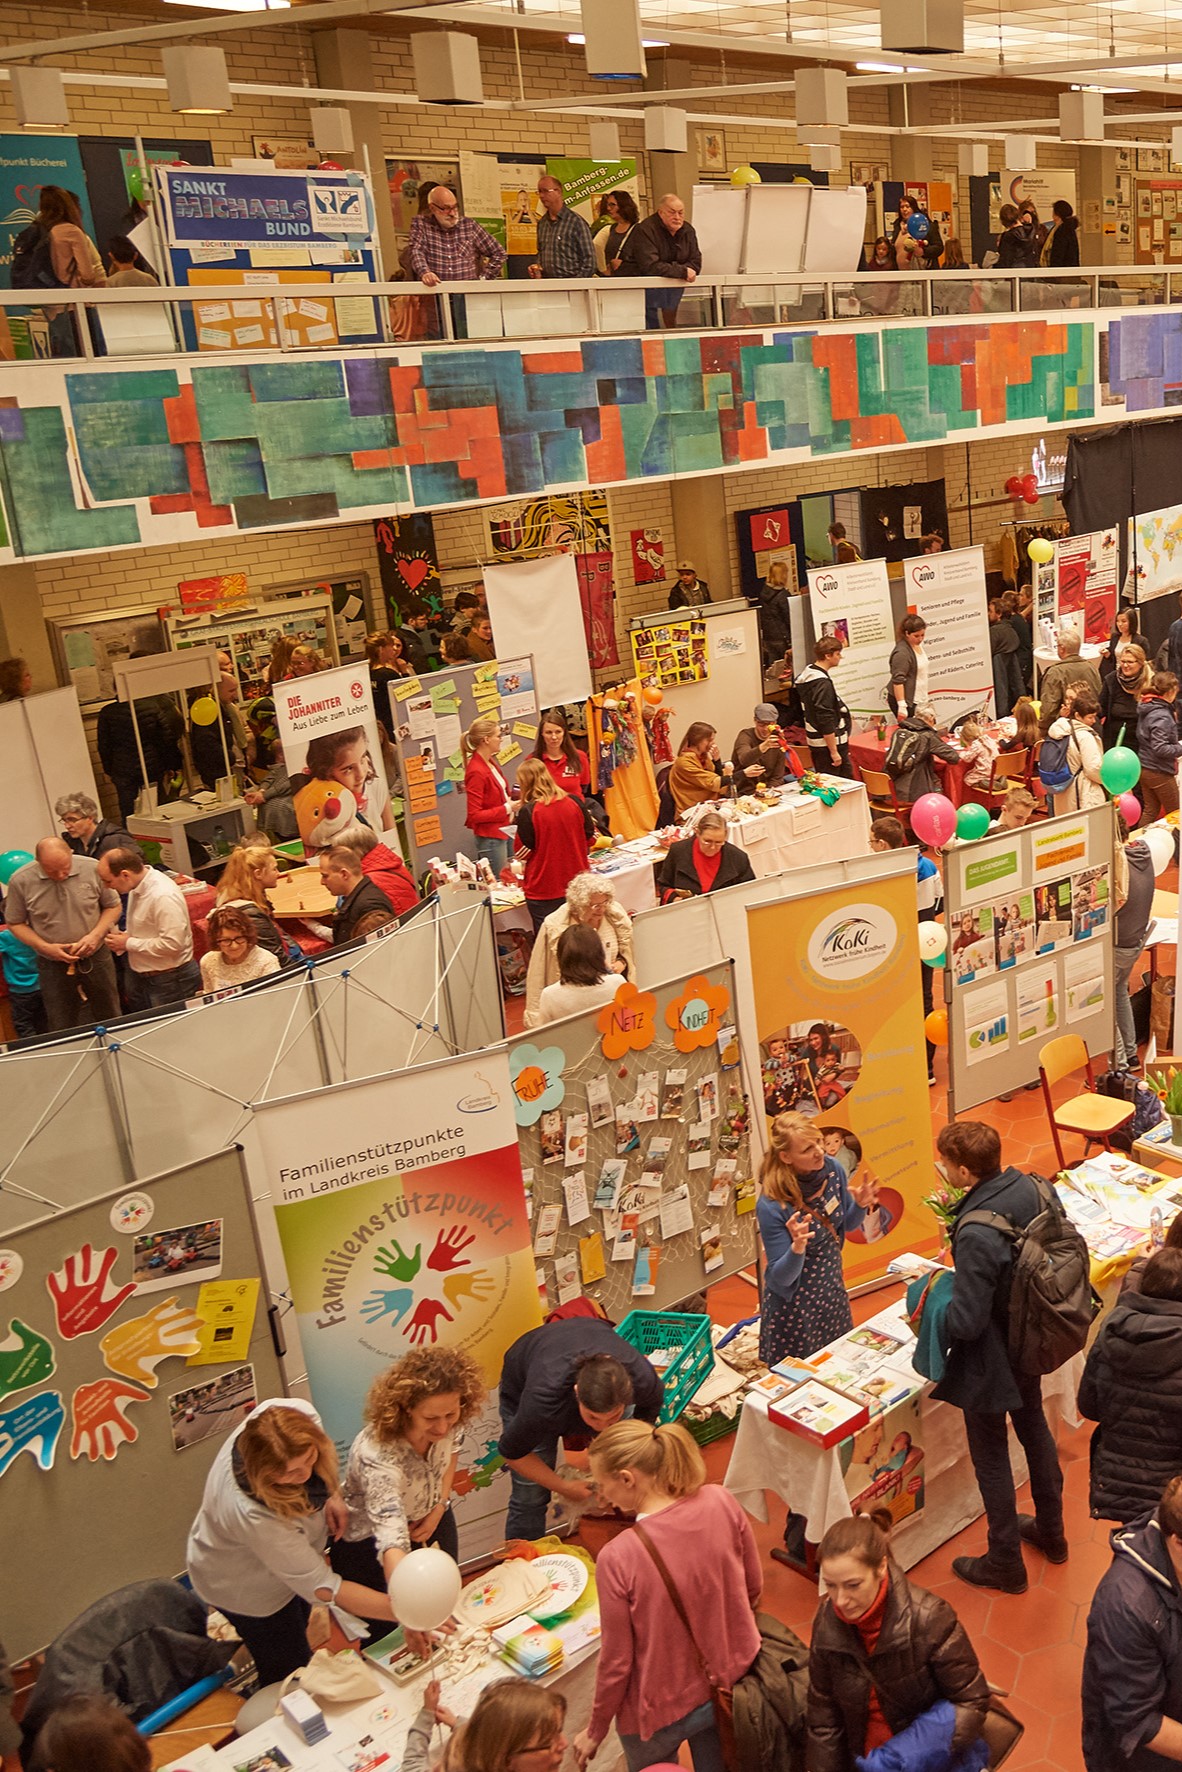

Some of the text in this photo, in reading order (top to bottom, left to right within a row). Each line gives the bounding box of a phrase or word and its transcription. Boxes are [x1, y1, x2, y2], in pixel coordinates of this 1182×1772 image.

[30, 157, 67, 168] Bücherei
[172, 180, 226, 196] SANKT
[564, 166, 608, 192] Bamberg-
[565, 167, 631, 206] m-Anfassen.de
[175, 196, 309, 220] MICHAELS
[266, 222, 311, 236] BUND
[822, 581, 838, 592] AWO
[919, 571, 935, 582] AWO
[921, 598, 965, 611] Senioren und Pflege
[964, 611, 981, 621] Familie
[923, 636, 945, 646] Migration
[287, 695, 302, 709] DIE
[288, 696, 342, 720] JOHANNITER
[293, 704, 369, 732] Aus Liebe zum Leben
[832, 929, 870, 952] KoKi
[822, 943, 887, 963] Netzwerk frühe Kindheit
[610, 1008, 644, 1036] NETZ
[676, 1005, 716, 1031] KINDHEIT
[279, 1126, 465, 1183] Familienstützpunkte
[282, 1143, 466, 1201] im Landkreis Bamberg
[316, 1191, 513, 1330] Familienstützpunkt
[532, 1557, 584, 1593] milienstützpunkt
